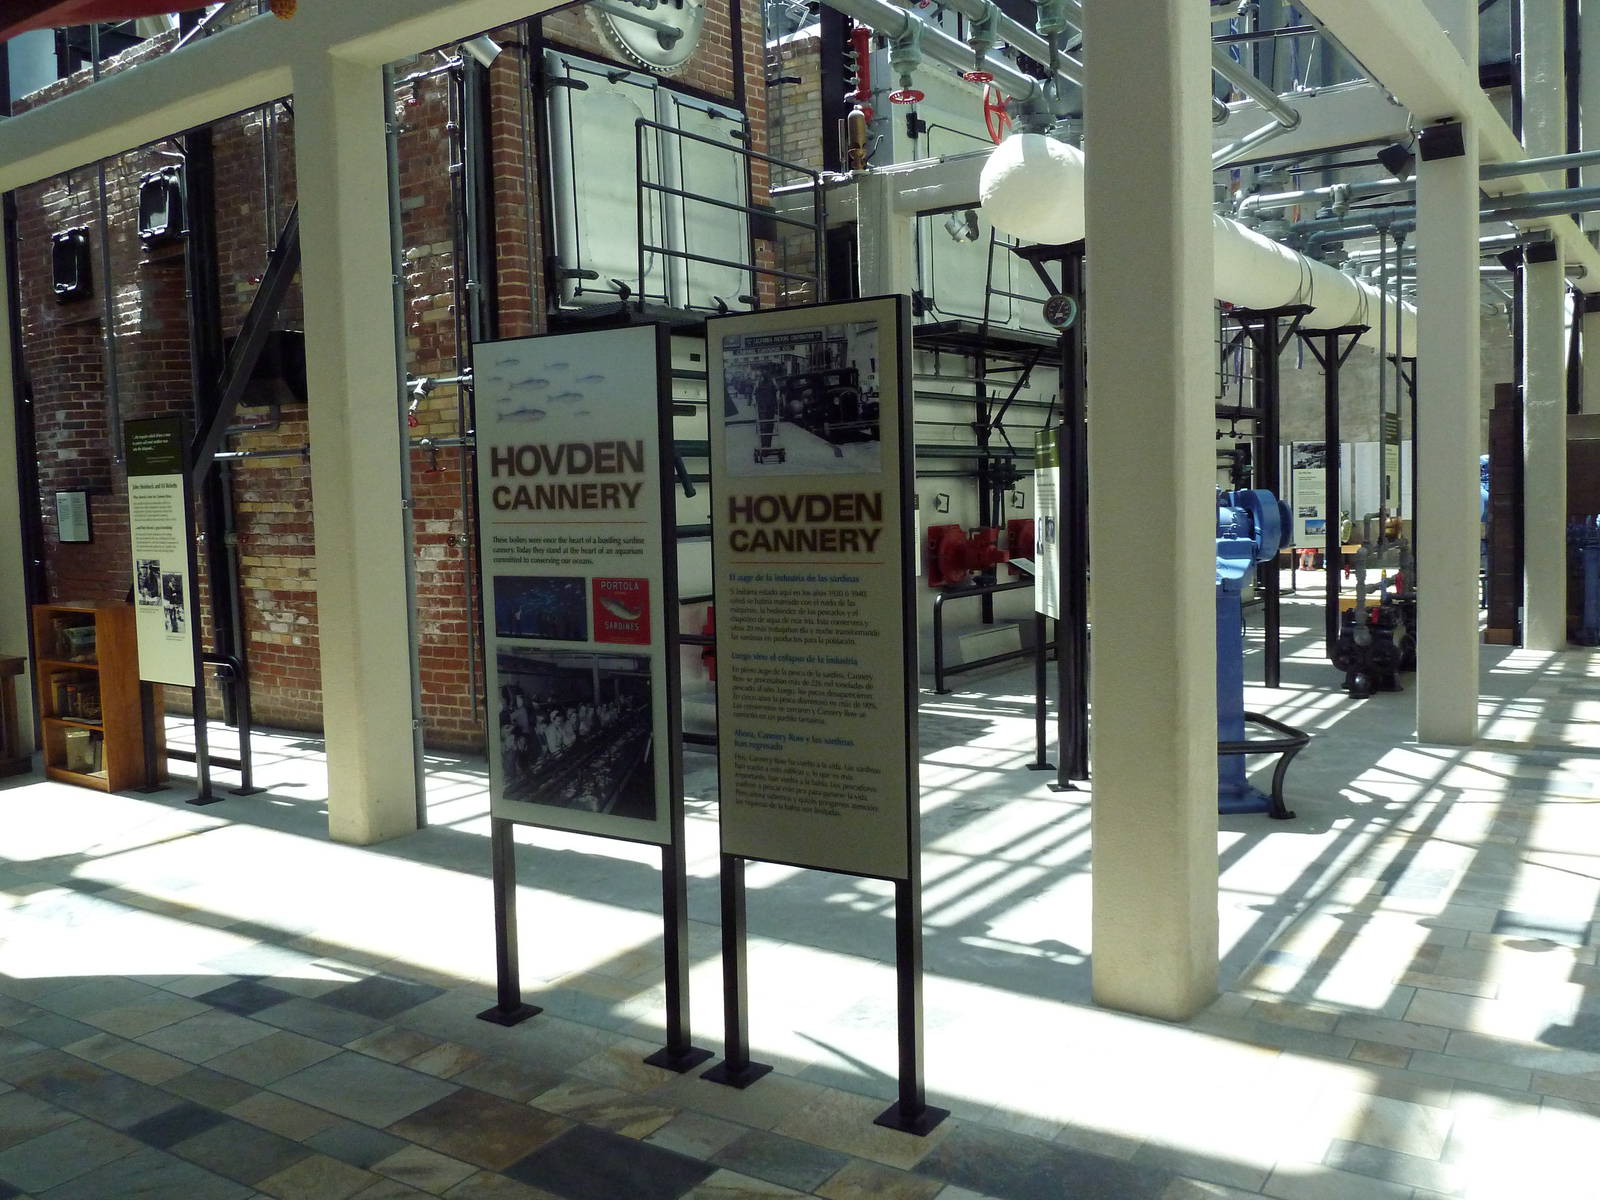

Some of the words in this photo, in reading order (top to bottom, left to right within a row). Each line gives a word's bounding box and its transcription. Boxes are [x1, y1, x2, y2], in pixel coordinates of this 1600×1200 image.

[491, 440, 644, 477] HOVDEN
[492, 481, 644, 511] CANNERY
[729, 491, 882, 524] HOVDEN
[493, 536, 508, 544] These
[558, 536, 568, 544] the
[569, 536, 584, 544] heart
[585, 536, 592, 544] of
[623, 536, 645, 544] sardine
[730, 528, 881, 553] CANNERY
[517, 546, 532, 556] Today
[533, 546, 545, 556] they
[546, 546, 562, 554] stand
[570, 546, 580, 554] the
[581, 546, 596, 554] heart
[598, 546, 604, 554] of
[524, 556, 530, 564] to
[531, 556, 560, 566] conserving
[601, 581, 640, 591] PORTOLA
[604, 621, 640, 632] SARDINES
